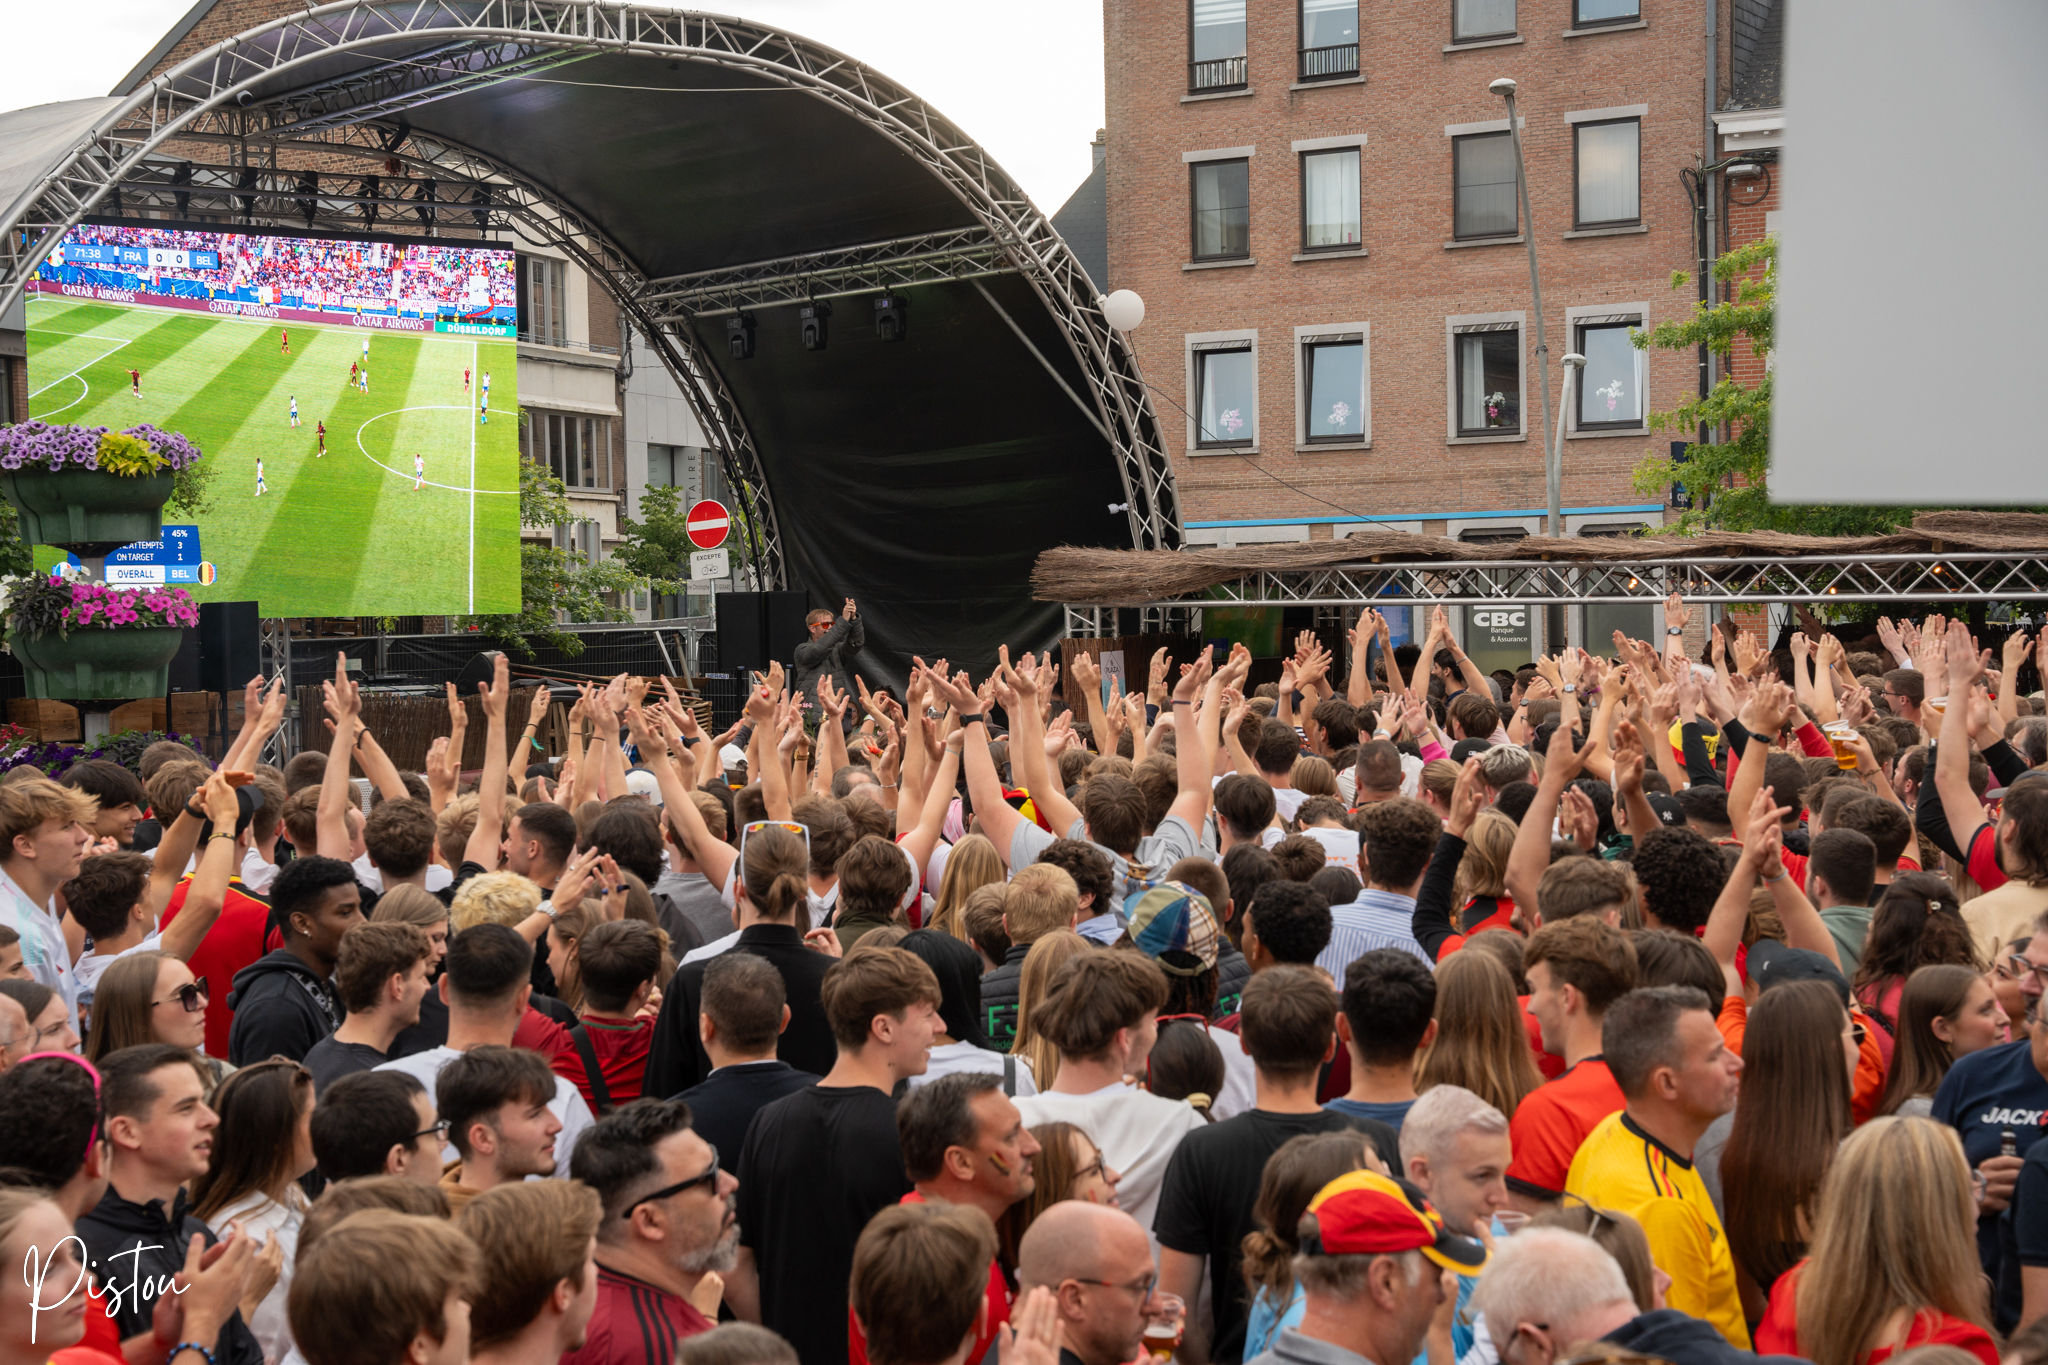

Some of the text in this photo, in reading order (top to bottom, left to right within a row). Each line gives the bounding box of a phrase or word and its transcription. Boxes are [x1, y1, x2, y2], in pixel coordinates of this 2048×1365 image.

[74, 248, 101, 259] 71:38
[124, 251, 142, 262] FRA
[156, 253, 163, 263] 0
[176, 254, 183, 264] 0
[196, 256, 213, 266] BEL
[62, 284, 135, 303] QATAR AIRWAYS
[209, 301, 279, 318] QATAR AIRWAYS
[352, 315, 424, 331] QATAR AIRWAYS
[688, 455, 696, 510] TAIRE
[172, 529, 188, 538] 45%
[177, 541, 183, 549] 3
[116, 553, 183, 561] ON TARGET 1
[117, 570, 190, 578] OVERALL BEL
[1473, 611, 1525, 627] CBC
